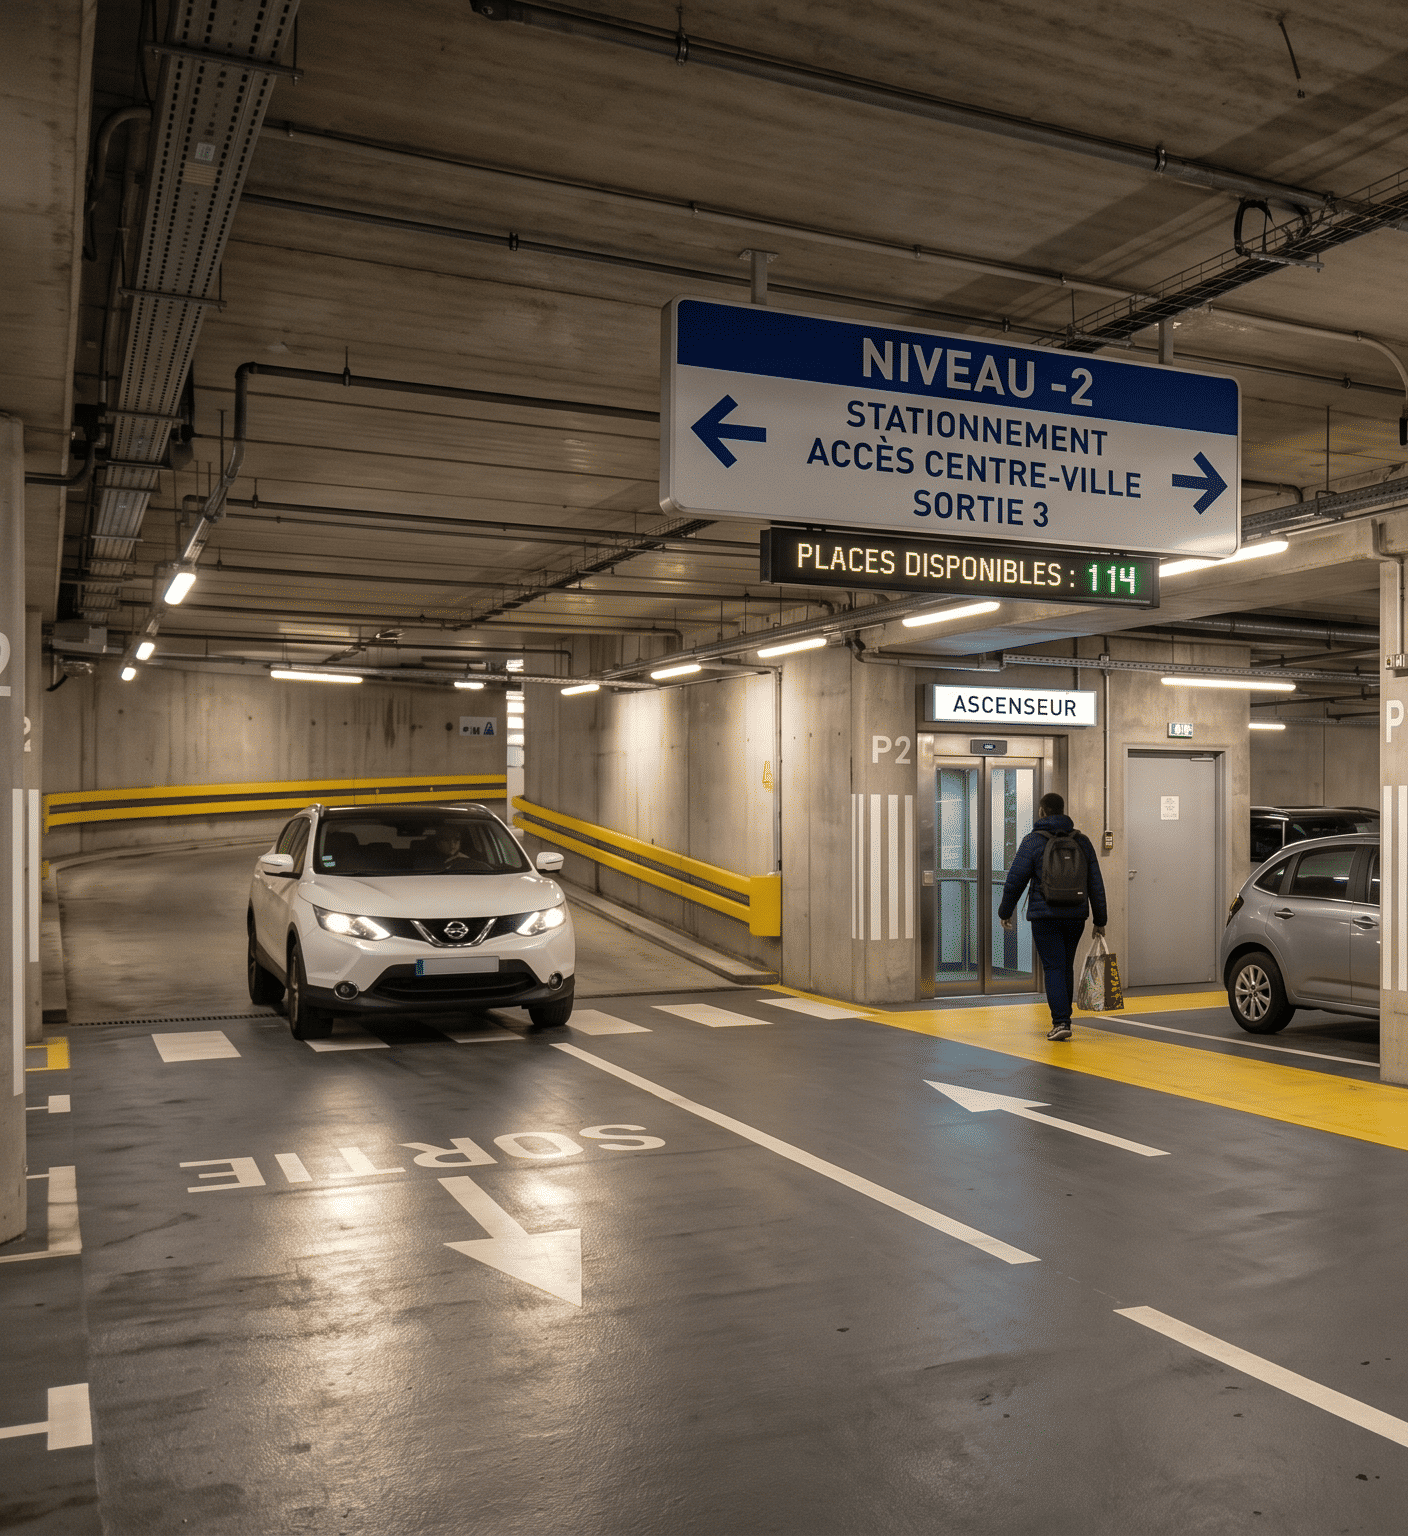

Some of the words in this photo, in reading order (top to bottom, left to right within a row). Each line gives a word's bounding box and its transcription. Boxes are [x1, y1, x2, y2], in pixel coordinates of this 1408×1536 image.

[862, 337, 1035, 399] NIVEAU
[1051, 367, 1093, 407] -2
[846, 400, 1108, 456] STATIONNEMENT
[806, 435, 915, 475] ACCÈS
[925, 450, 1142, 499] CENTRE-VILLE
[913, 489, 1024, 526] SORTIE
[1033, 501, 1049, 528] 3
[797, 543, 896, 575] PLACES
[905, 551, 1062, 587] DISPONIBLES
[1088, 564, 1136, 594] 114
[953, 695, 1077, 717] ASCENSEUR
[872, 735, 911, 764] P2
[179, 1124, 667, 1193] SORTIE
